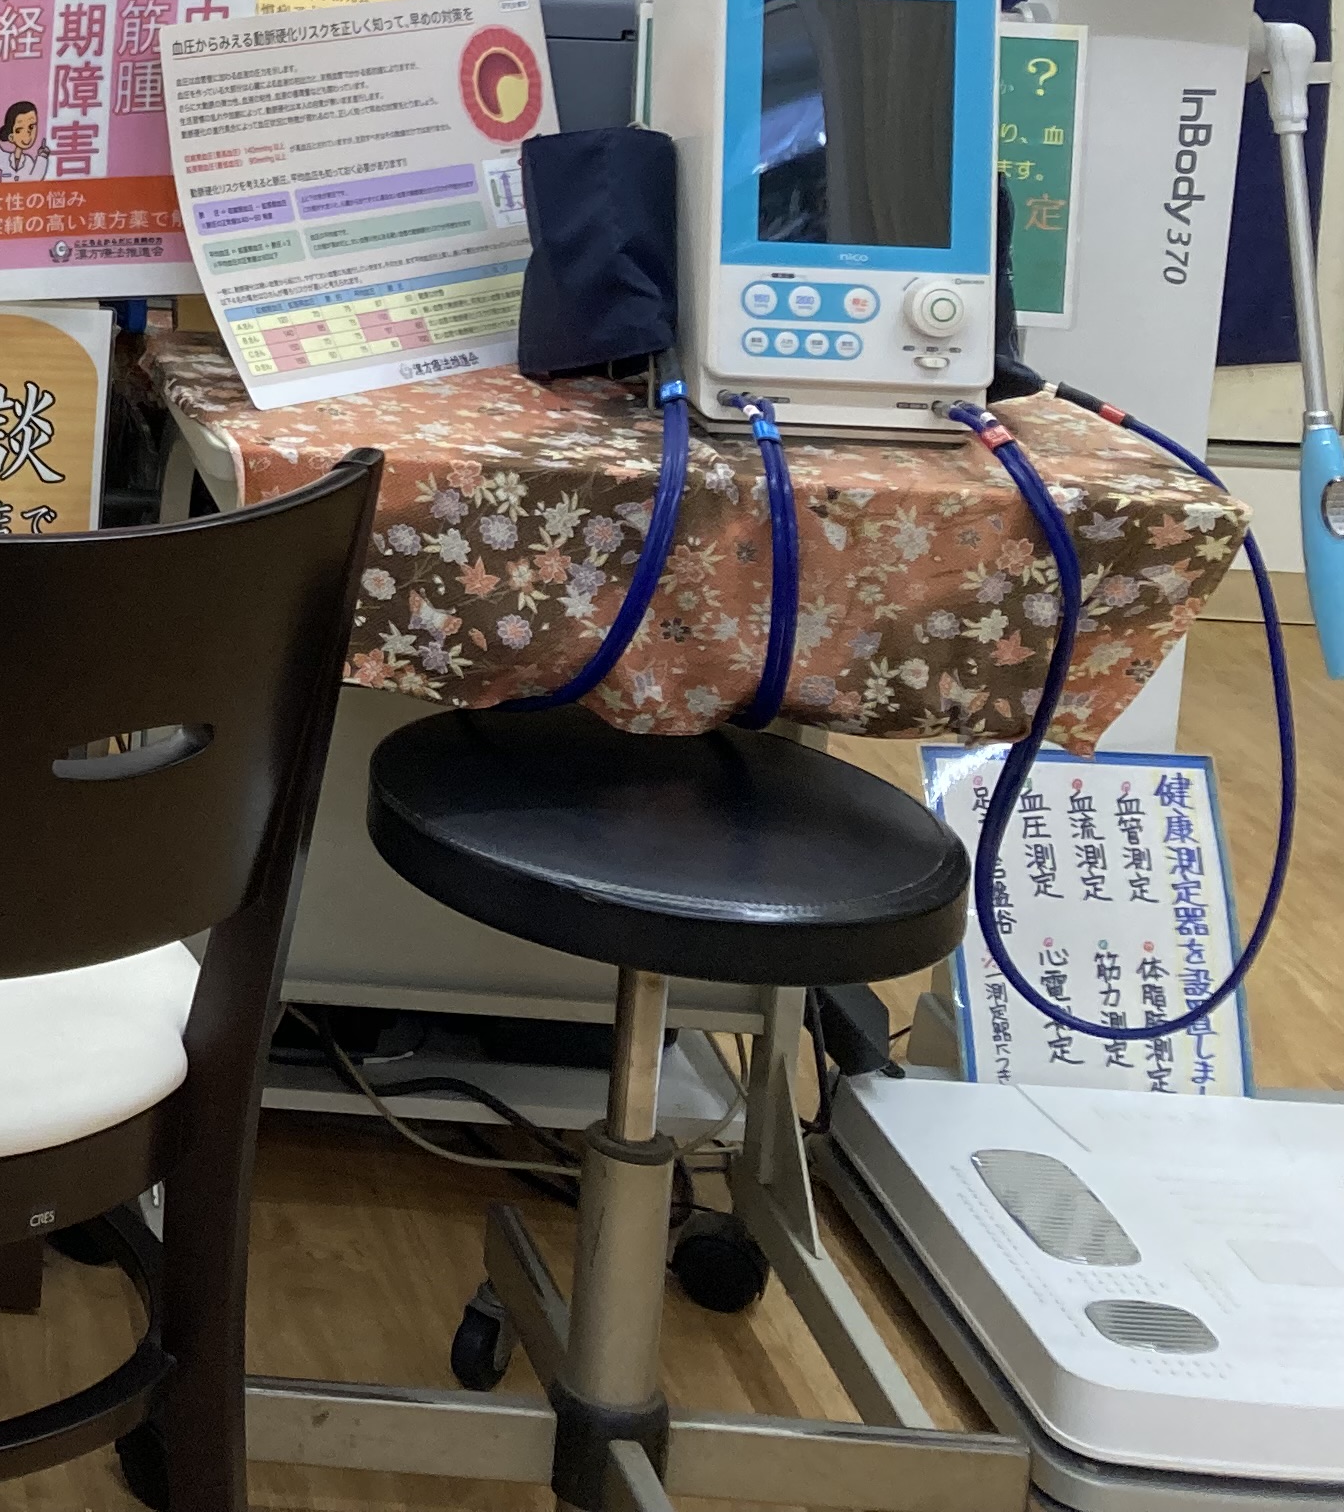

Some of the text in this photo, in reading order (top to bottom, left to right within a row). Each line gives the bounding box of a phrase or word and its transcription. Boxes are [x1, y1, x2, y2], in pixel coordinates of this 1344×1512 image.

[1016, 789, 1064, 900] 血圧測定
[1067, 790, 1113, 903] 血流測定
[1114, 791, 1160, 904] 血管測定
